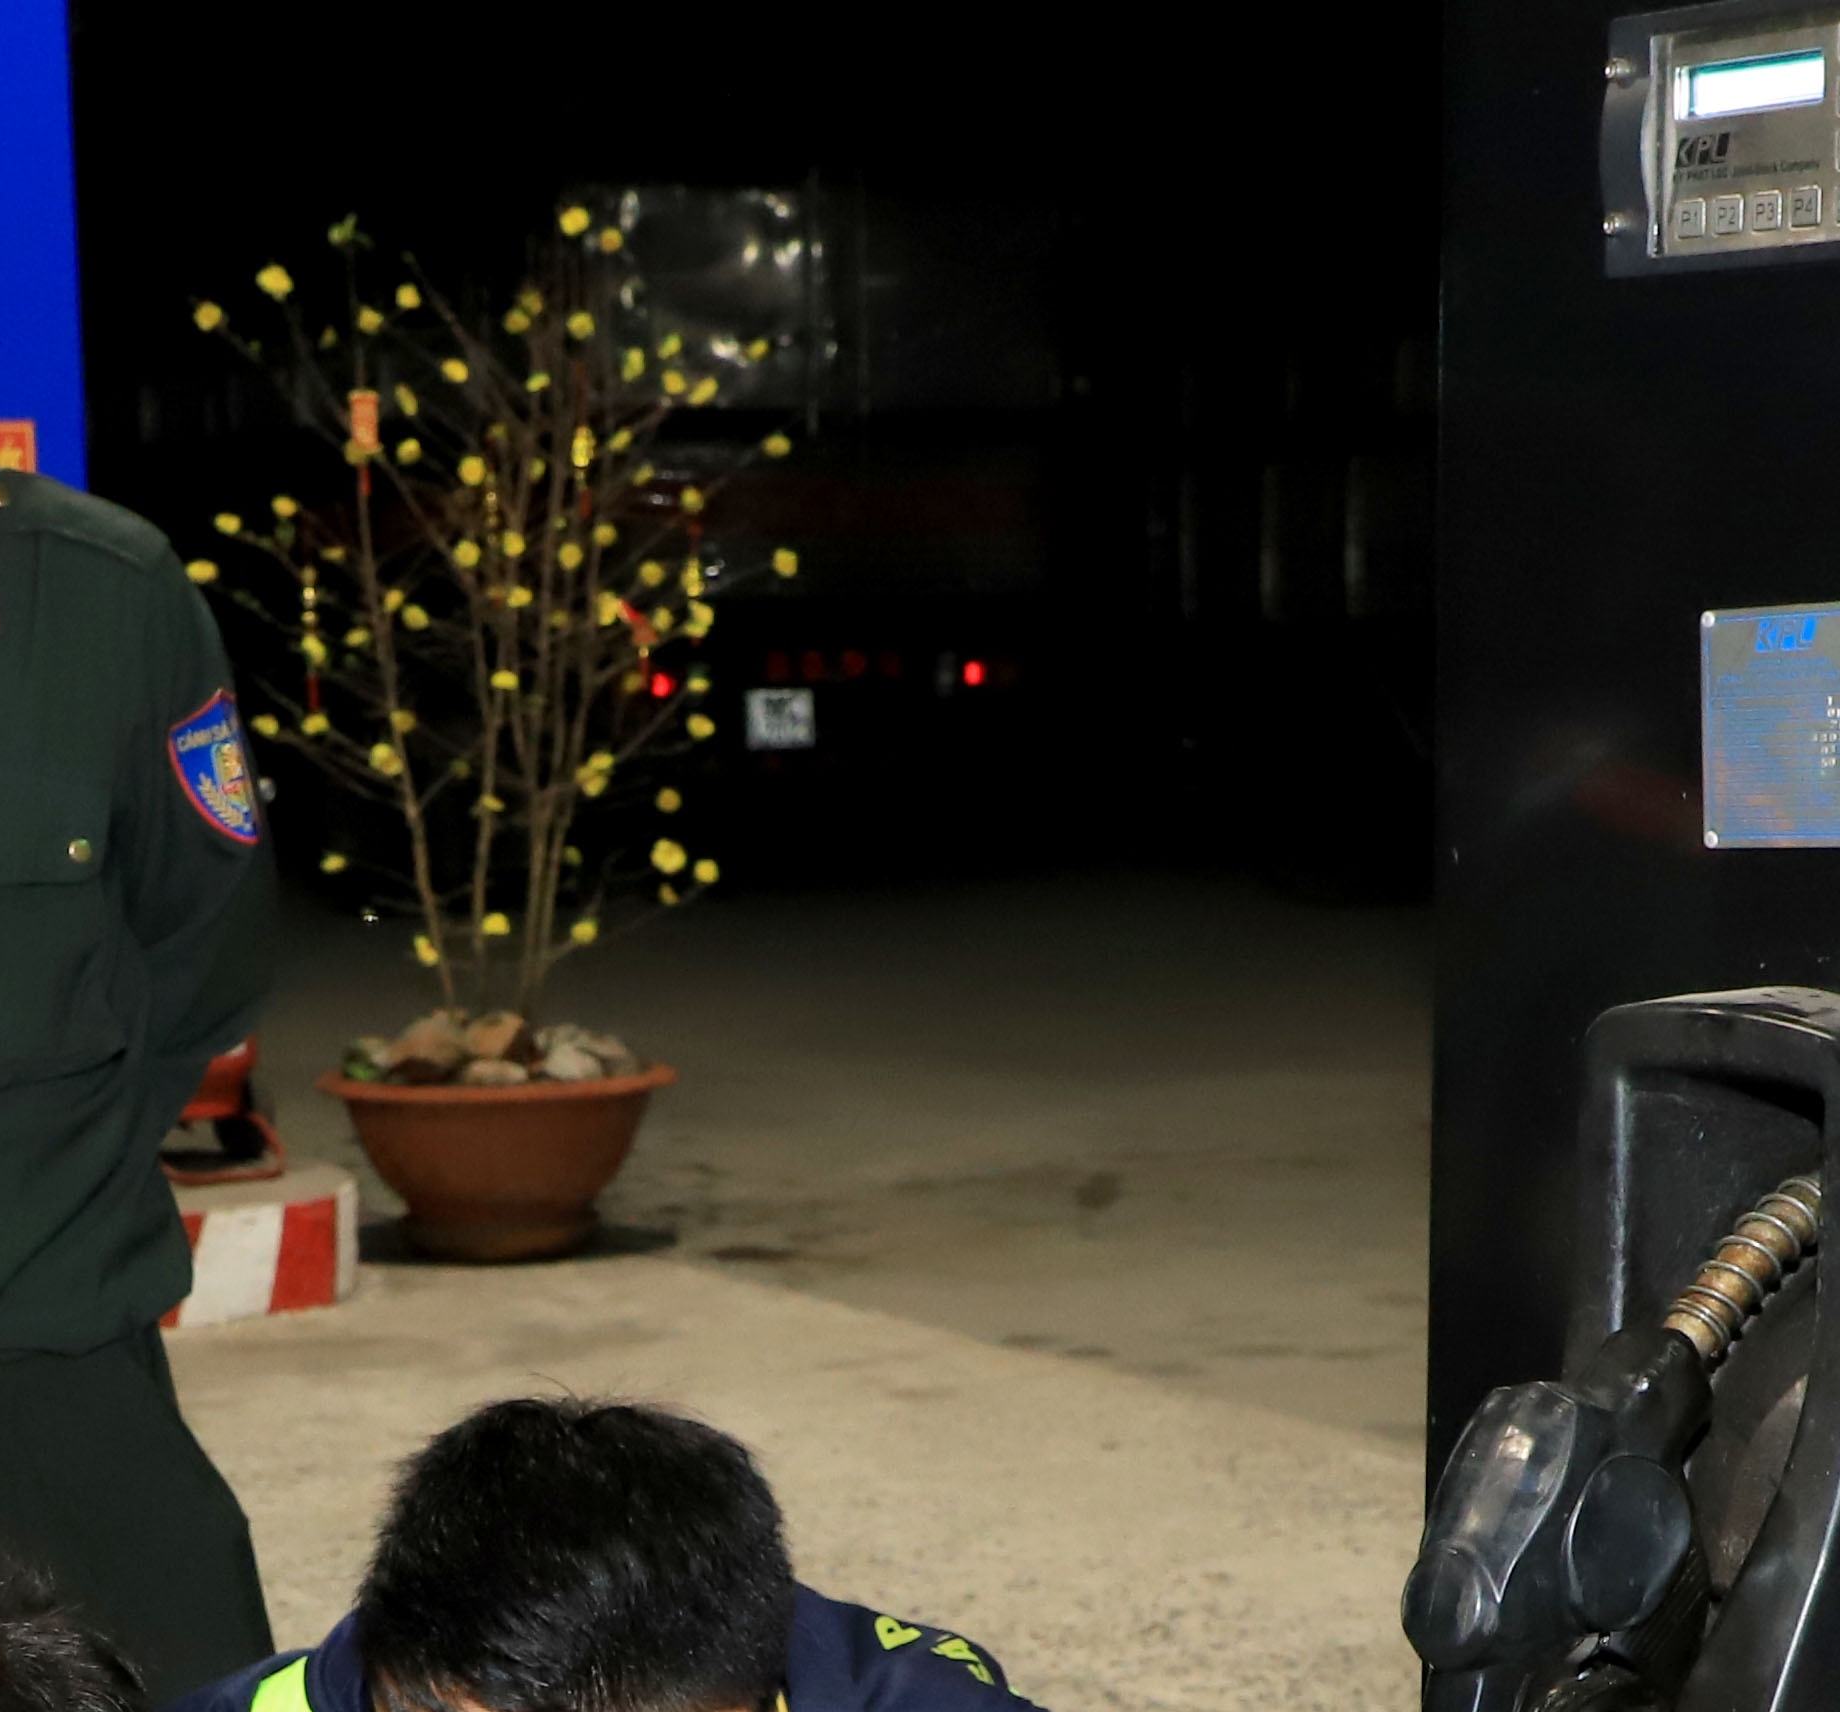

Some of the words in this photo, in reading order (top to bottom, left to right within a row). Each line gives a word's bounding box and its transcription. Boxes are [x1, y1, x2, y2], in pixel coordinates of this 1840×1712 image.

[1675, 131, 1731, 168] KPL
[1680, 210, 1698, 228] P1
[1717, 206, 1736, 226] P2
[1755, 202, 1775, 222] P3
[1794, 198, 1813, 217] P4
